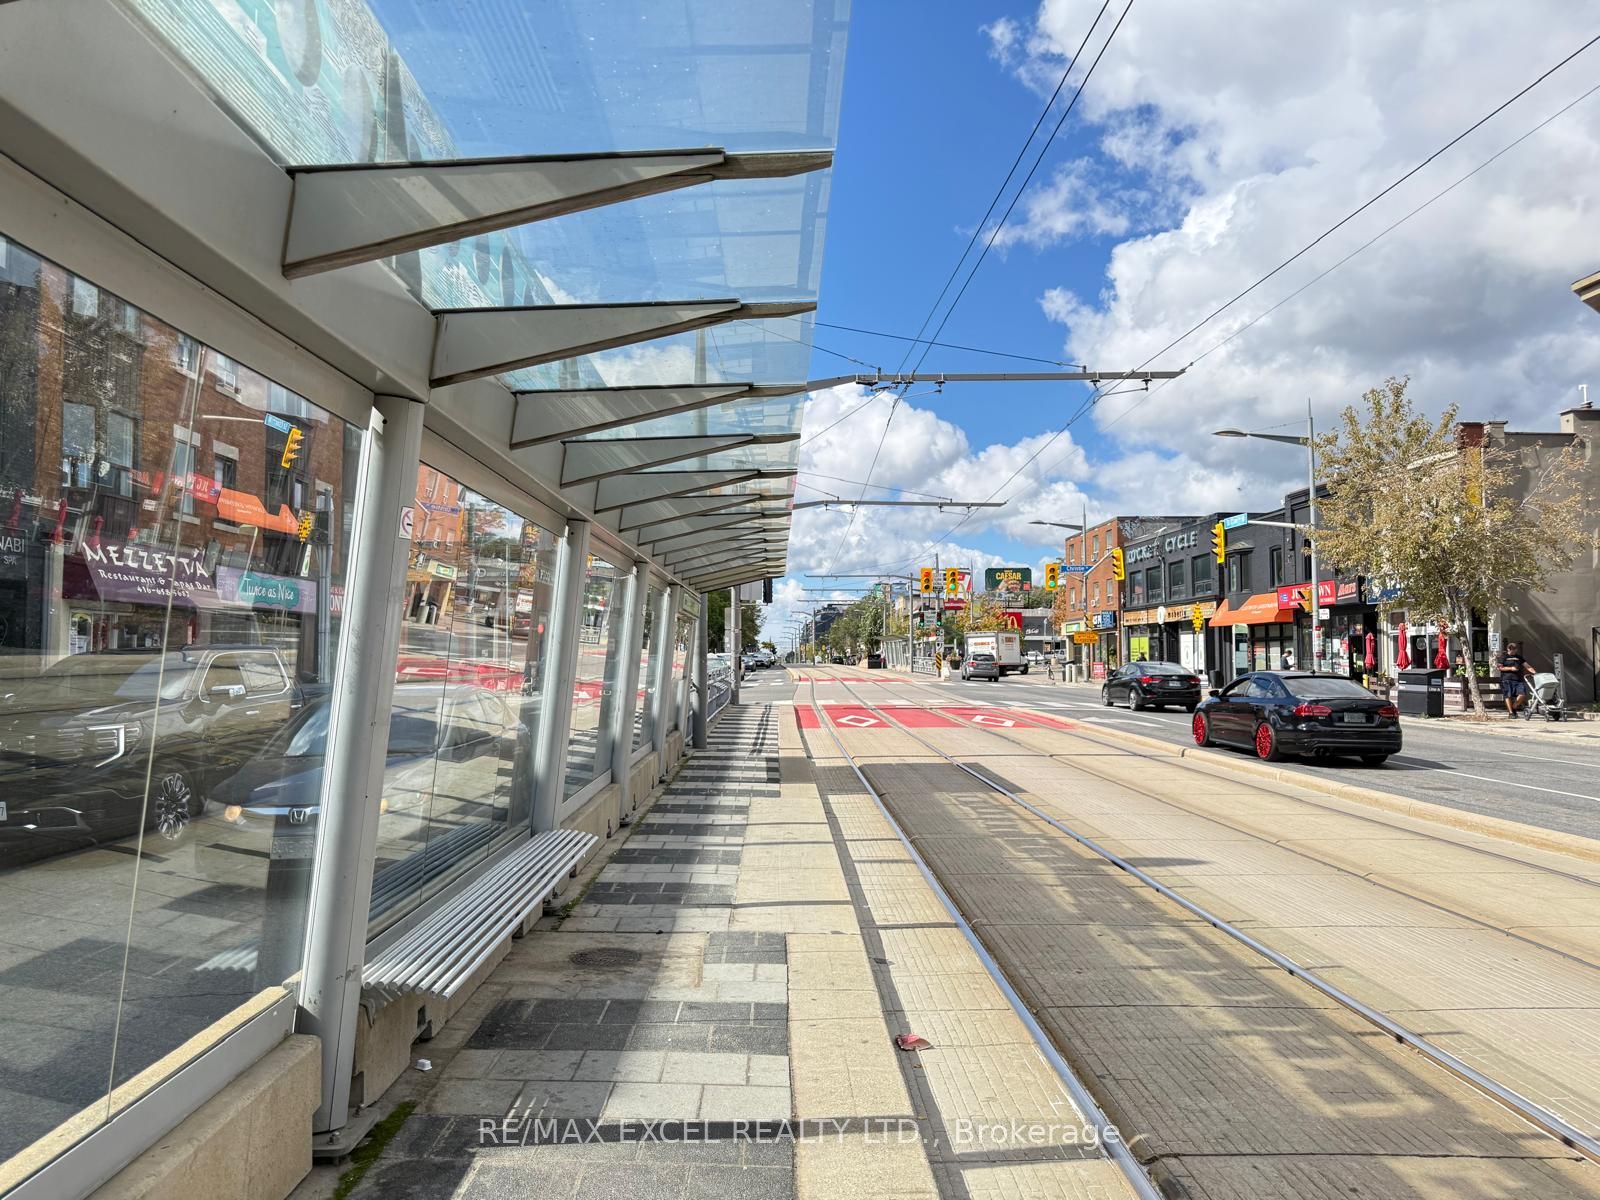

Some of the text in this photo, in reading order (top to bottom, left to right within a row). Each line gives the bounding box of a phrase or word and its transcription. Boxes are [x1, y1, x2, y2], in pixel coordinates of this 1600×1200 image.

[1165, 530, 1198, 552] CYCLE
[3, 555, 17, 565] SPA
[98, 569, 157, 587] Restaurant
[196, 581, 211, 591] Bar
[995, 572, 1022, 581] CAESAR
[243, 577, 266, 596] Twice
[267, 586, 278, 598] as
[278, 583, 295, 601] Nice
